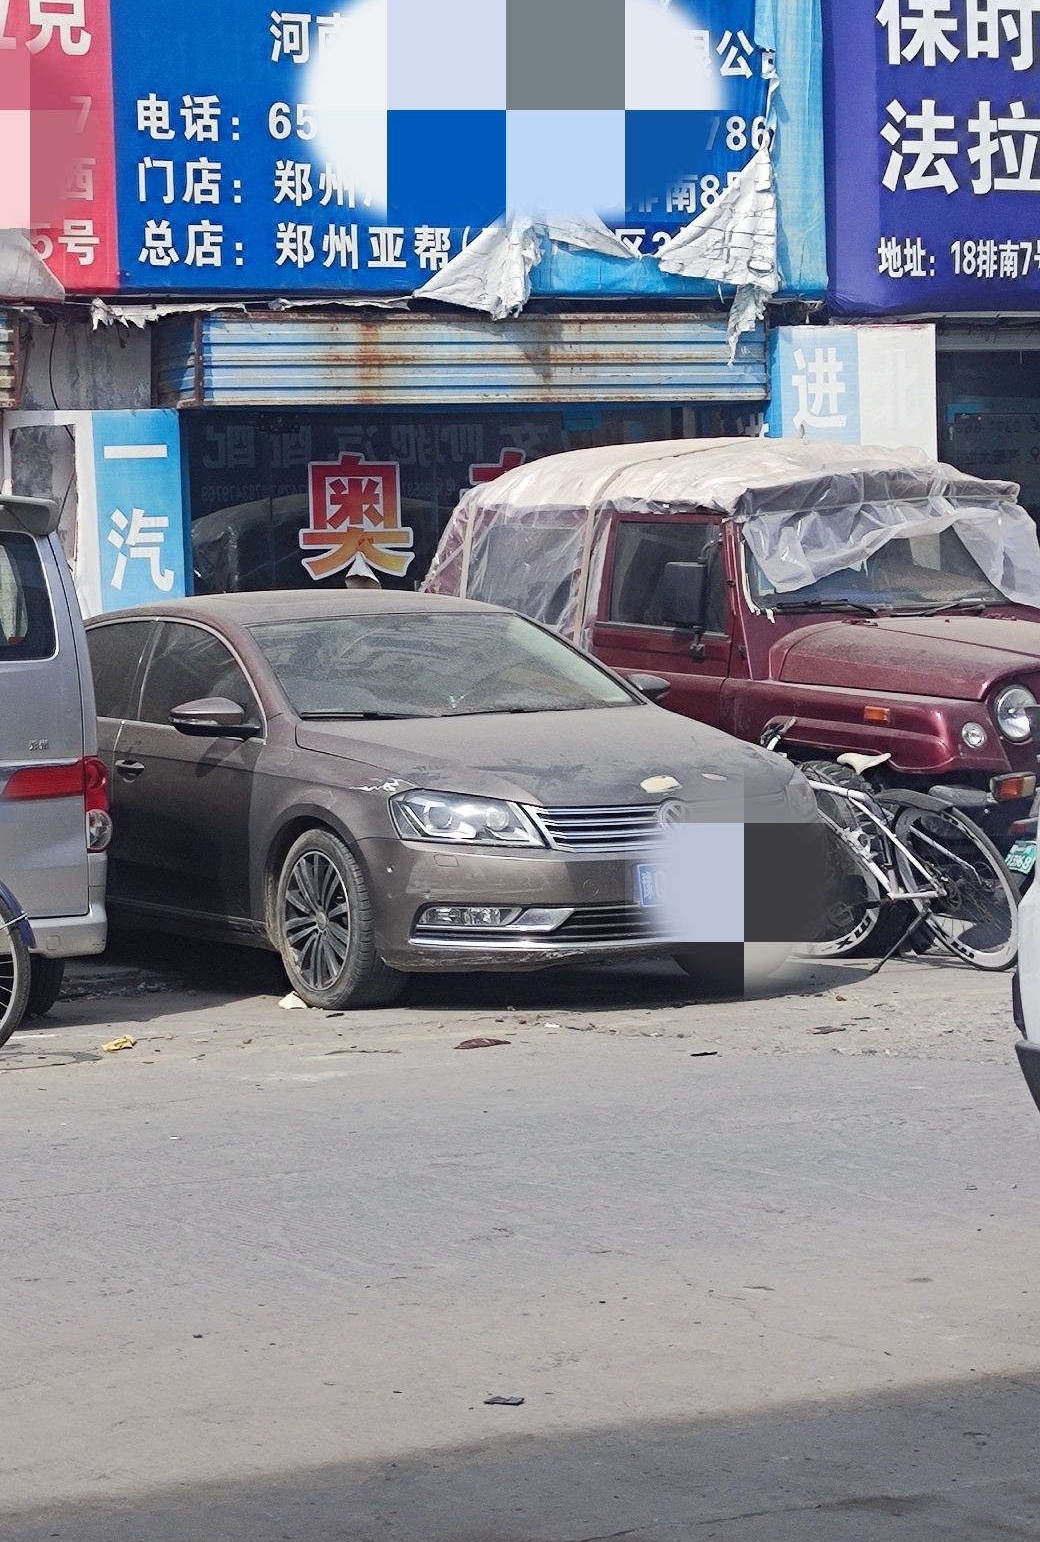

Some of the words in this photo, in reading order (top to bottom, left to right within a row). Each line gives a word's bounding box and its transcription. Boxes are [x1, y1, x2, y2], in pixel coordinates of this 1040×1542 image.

[791, 347, 847, 430] 进
[103, 444, 174, 592] 一汽
[298, 451, 415, 581] 奥
